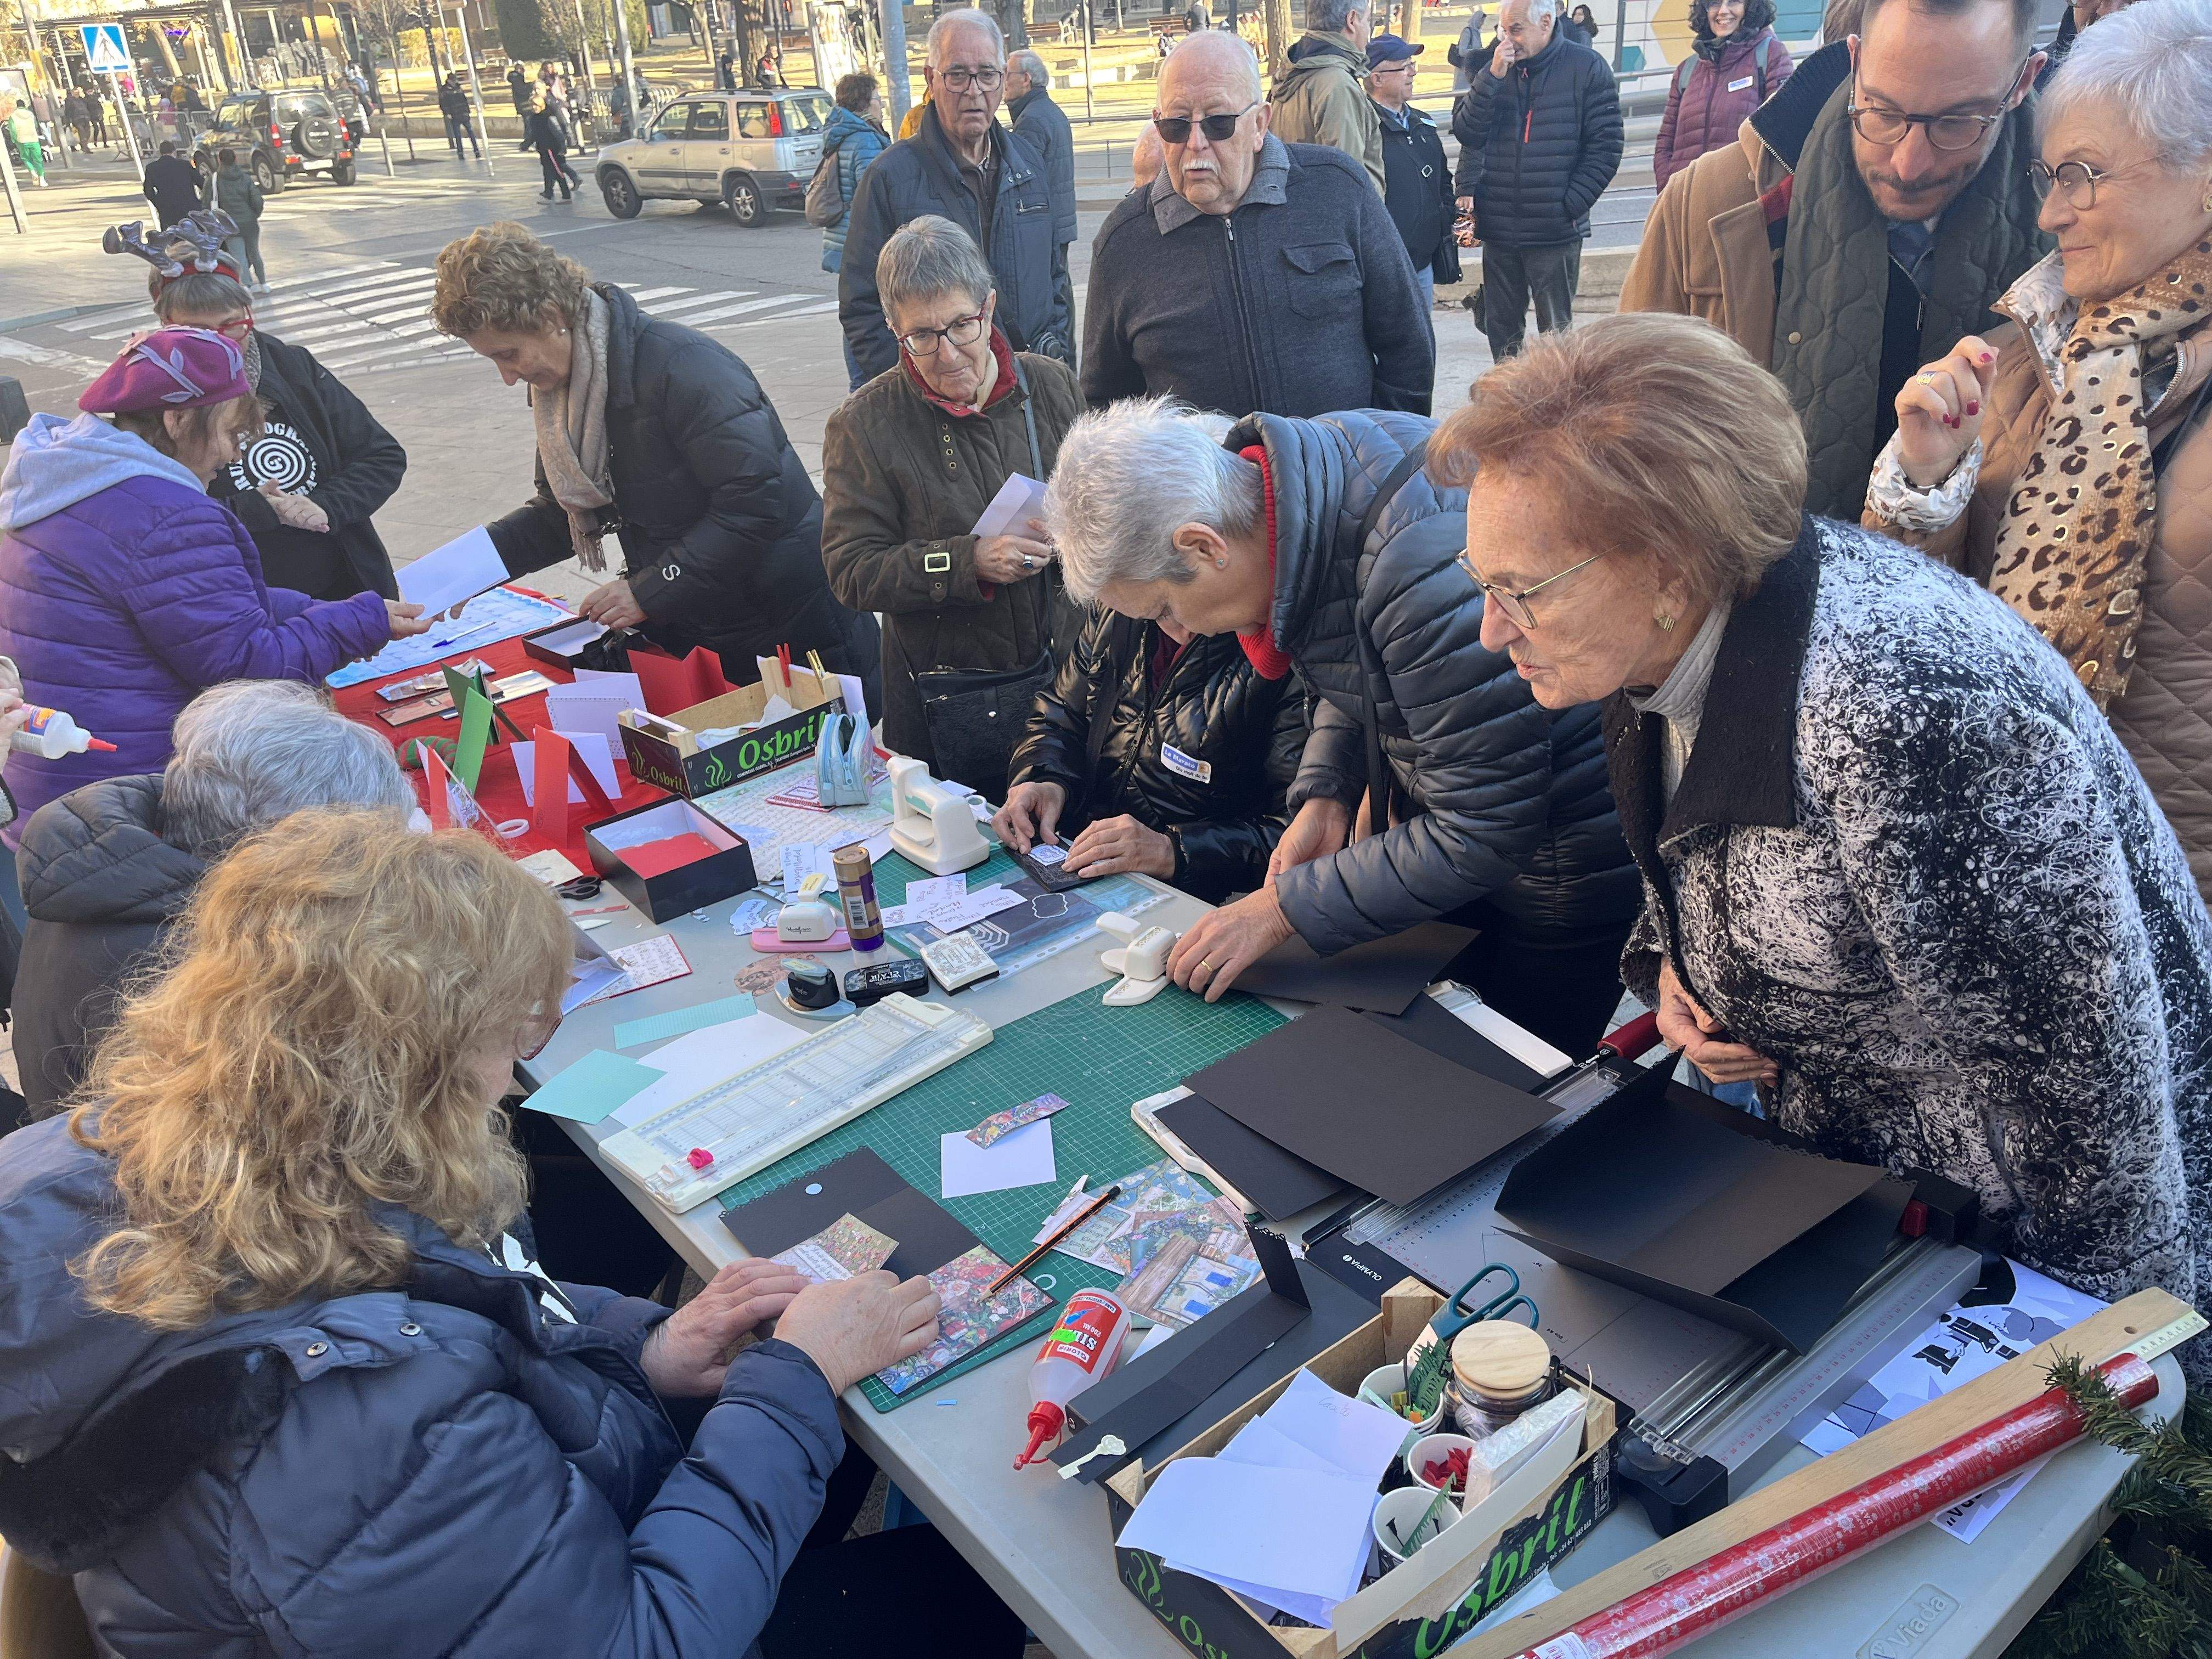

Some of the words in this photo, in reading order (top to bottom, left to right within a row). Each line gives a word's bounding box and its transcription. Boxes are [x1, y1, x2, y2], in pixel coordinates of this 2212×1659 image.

[1164, 749, 1171, 757] La
[1351, 1259, 1382, 1281] OLYMPIA
[1091, 1327, 1102, 1338] 200
[1533, 1562, 1547, 1575] Spain
[1887, 1596, 1948, 1647] Viada
